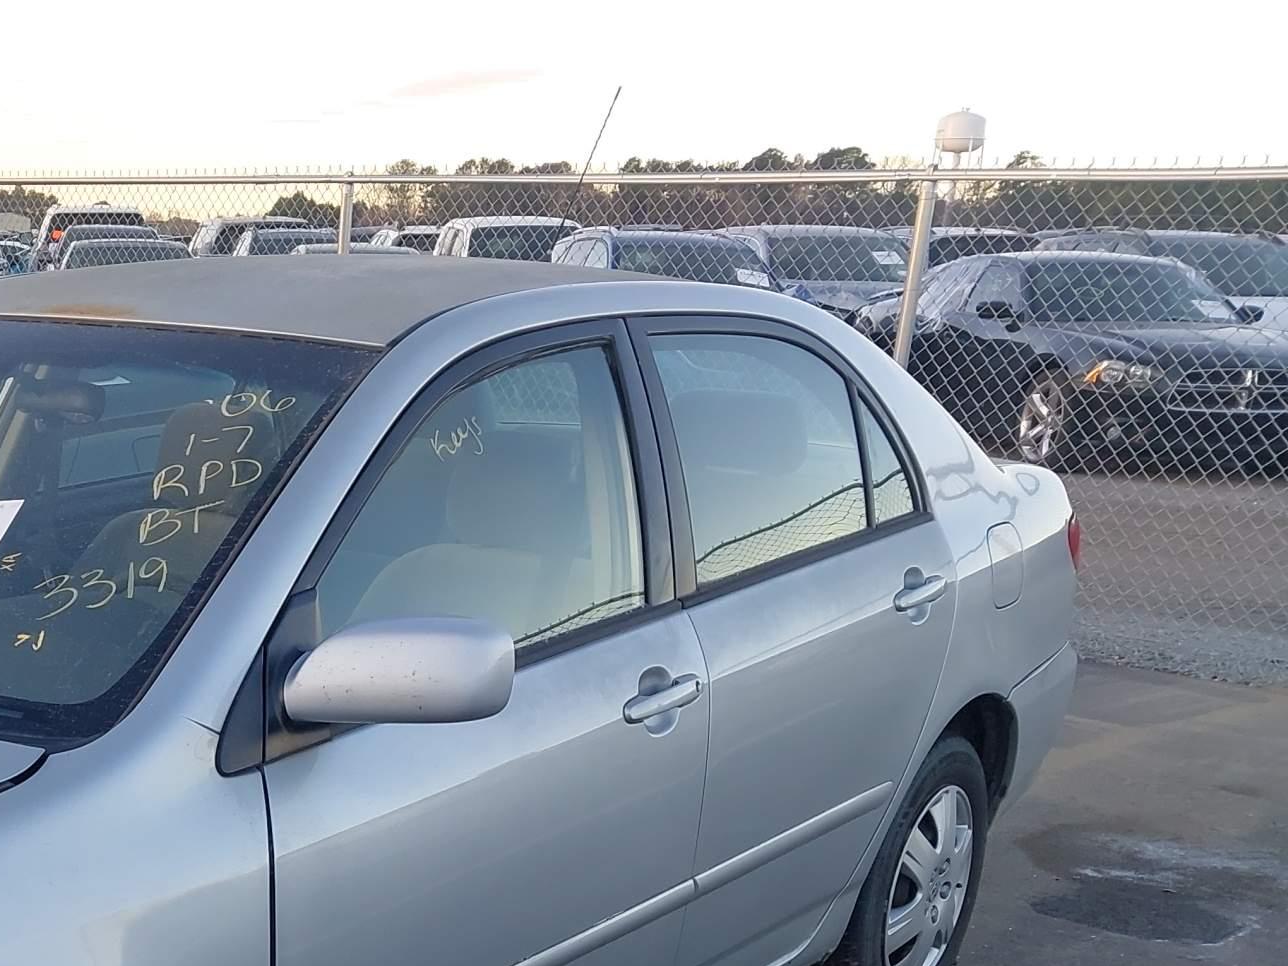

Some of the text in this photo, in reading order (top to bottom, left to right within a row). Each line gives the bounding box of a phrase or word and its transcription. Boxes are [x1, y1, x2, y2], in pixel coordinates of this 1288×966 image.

[185, 425, 256, 456] 1-7
[152, 459, 263, 501] RPD
[139, 500, 225, 546] BT
[32, 556, 168, 621] 3319
